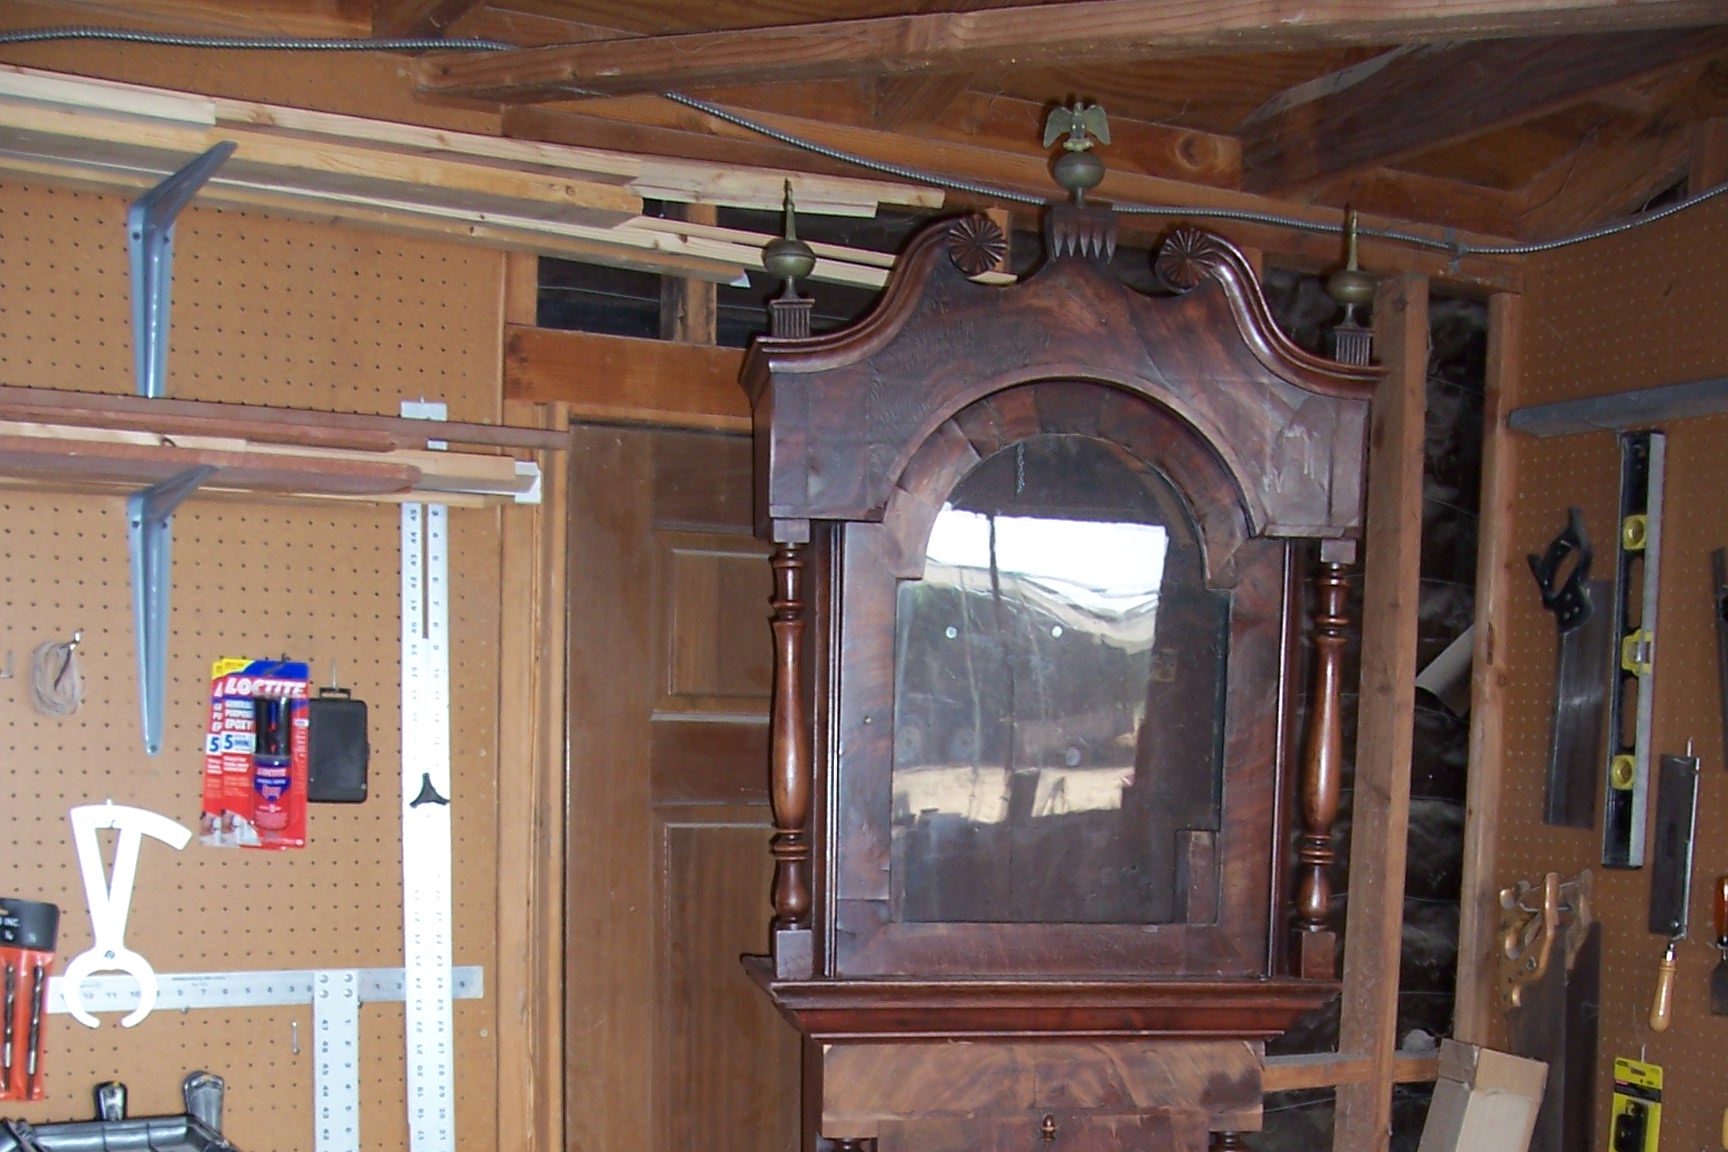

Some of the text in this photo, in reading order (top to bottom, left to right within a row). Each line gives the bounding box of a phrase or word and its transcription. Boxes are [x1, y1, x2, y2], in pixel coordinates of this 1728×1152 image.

[224, 677, 307, 698] LOCTITE
[225, 718, 253, 730] EPOXY
[209, 736, 219, 752] 5
[224, 733, 233, 749] 5
